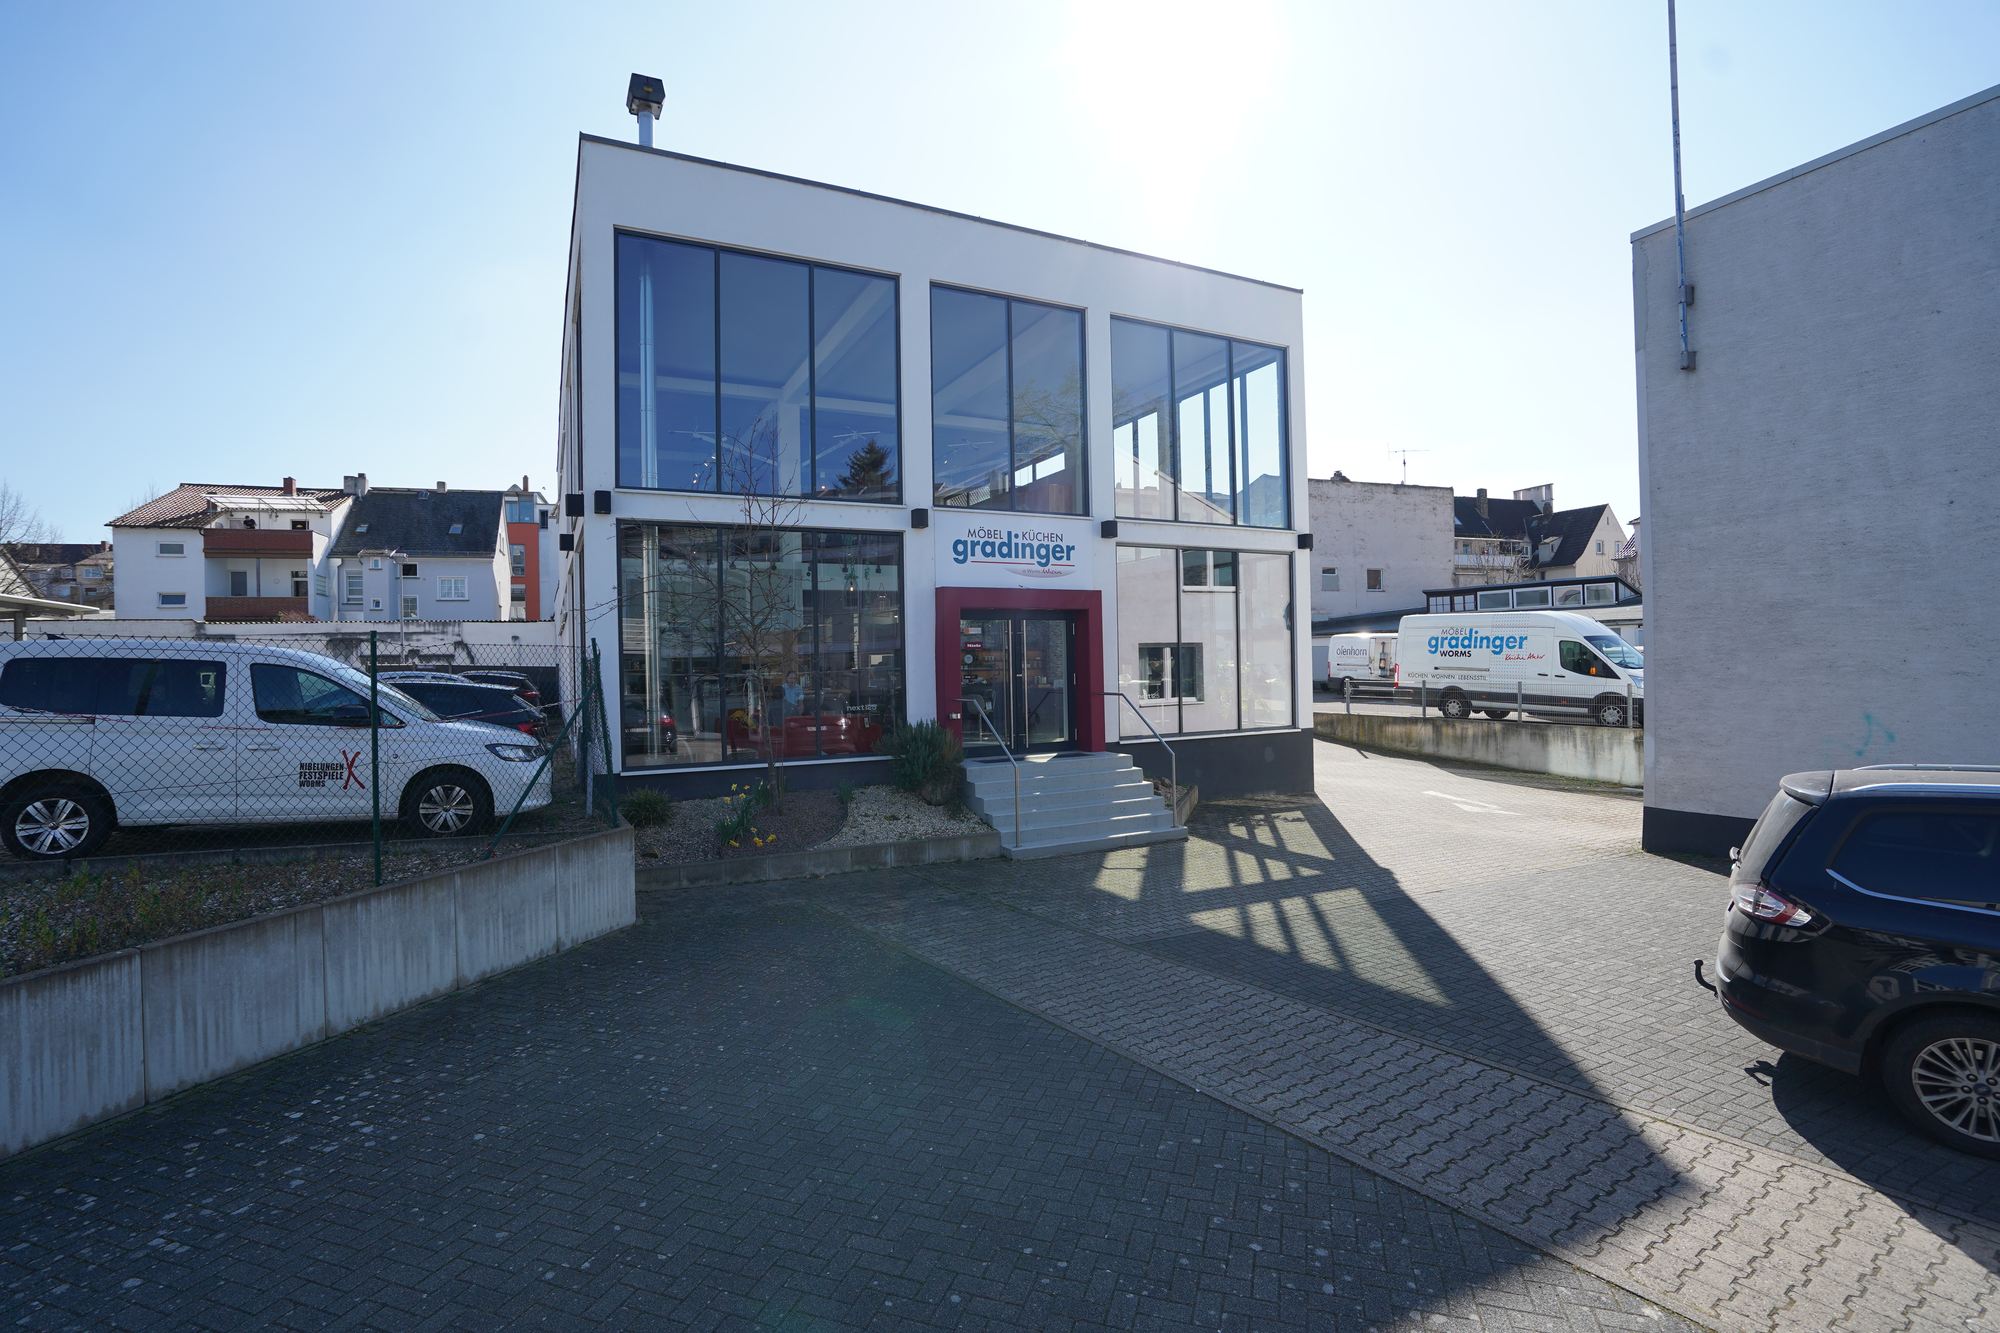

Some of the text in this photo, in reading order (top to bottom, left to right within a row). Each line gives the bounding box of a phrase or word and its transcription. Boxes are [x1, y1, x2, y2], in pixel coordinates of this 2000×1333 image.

[967, 526, 1064, 543] MÖBEL KÜCHEN
[952, 531, 1076, 567] gradinger
[1440, 627, 1468, 636] MÖBEL
[1427, 628, 1528, 655] gradinger
[1336, 645, 1367, 656] ofenhorn
[1440, 650, 1472, 658] WORMS
[299, 762, 344, 771] NIBELUNGEN
[299, 771, 344, 780] FESTSPIELE
[299, 780, 326, 788] WORMS
